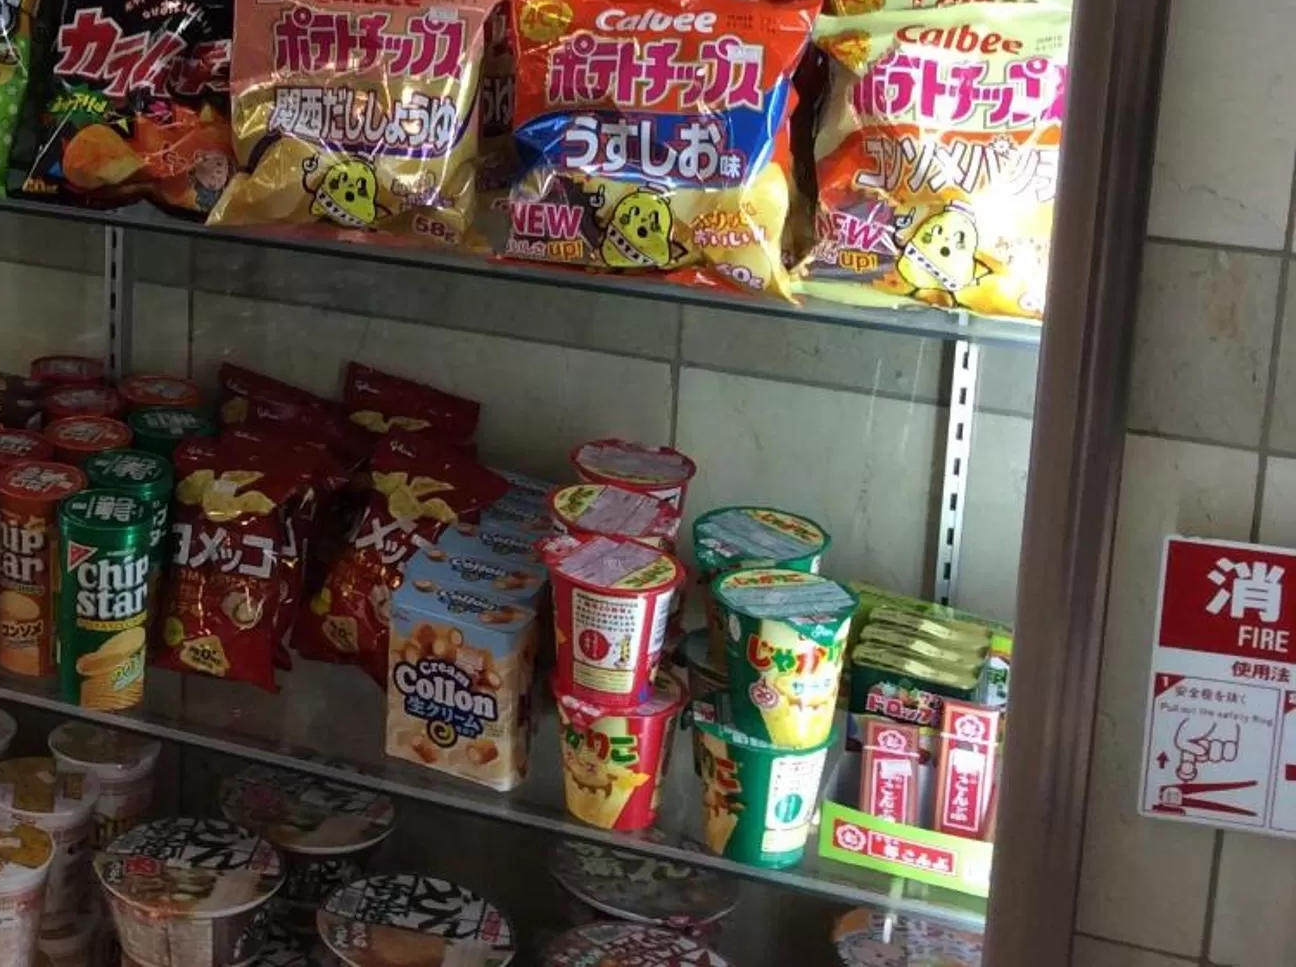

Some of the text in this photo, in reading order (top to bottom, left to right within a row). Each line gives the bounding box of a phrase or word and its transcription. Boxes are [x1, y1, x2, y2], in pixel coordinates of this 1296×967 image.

[274, 6, 465, 80] ポテトチップス
[897, 24, 1024, 55] Calbee
[547, 33, 764, 112] ポテトチップス
[271, 87, 456, 150] 関西だししょうゆ
[510, 201, 584, 239] NEW
[77, 553, 149, 591] chip
[1205, 557, 1286, 622] 消
[76, 585, 148, 620] star
[1237, 625, 1290, 653] FIRE
[419, 661, 471, 688] Cream
[1231, 661, 1292, 684] 使用法
[394, 664, 496, 720] Collon
